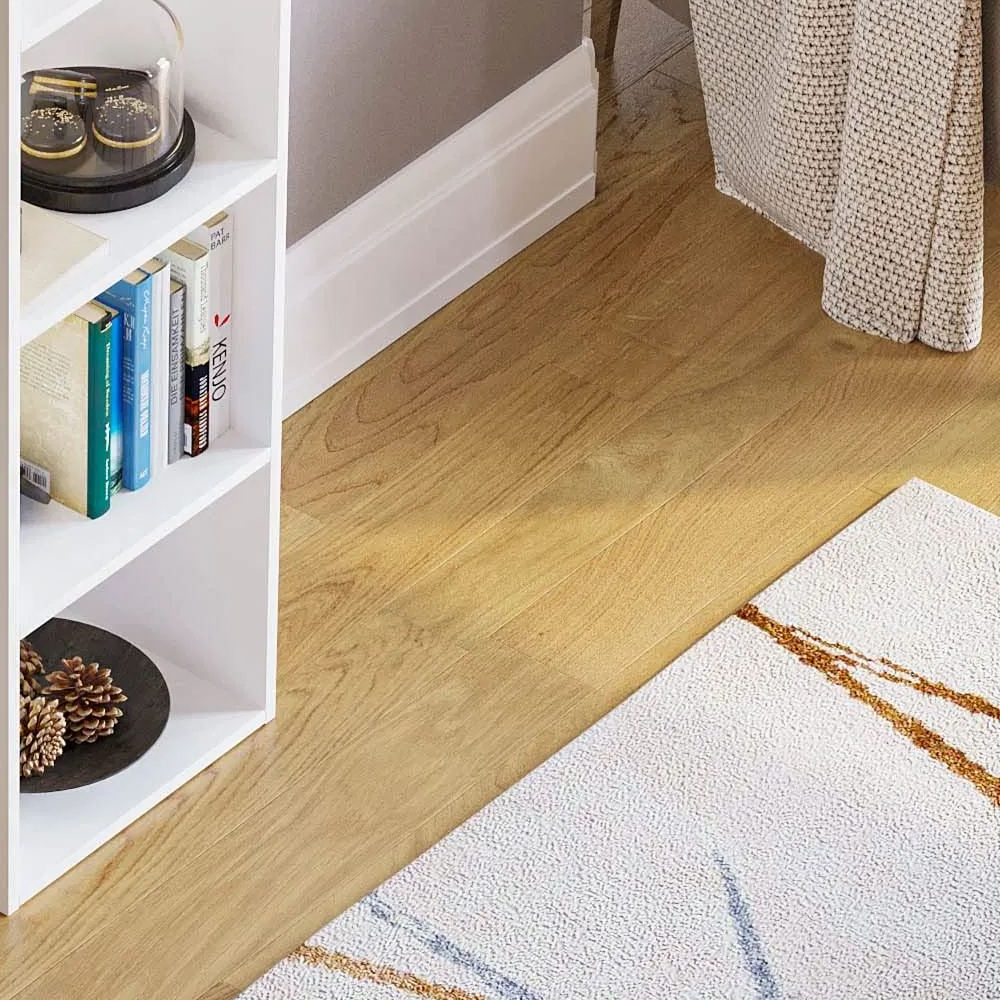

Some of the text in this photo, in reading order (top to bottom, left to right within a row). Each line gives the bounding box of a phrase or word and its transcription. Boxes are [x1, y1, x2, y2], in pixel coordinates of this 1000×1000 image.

[210, 227, 224, 241] PAT
[170, 309, 180, 406] DIE EINSAMKEIT
[212, 337, 227, 402] KENJO
